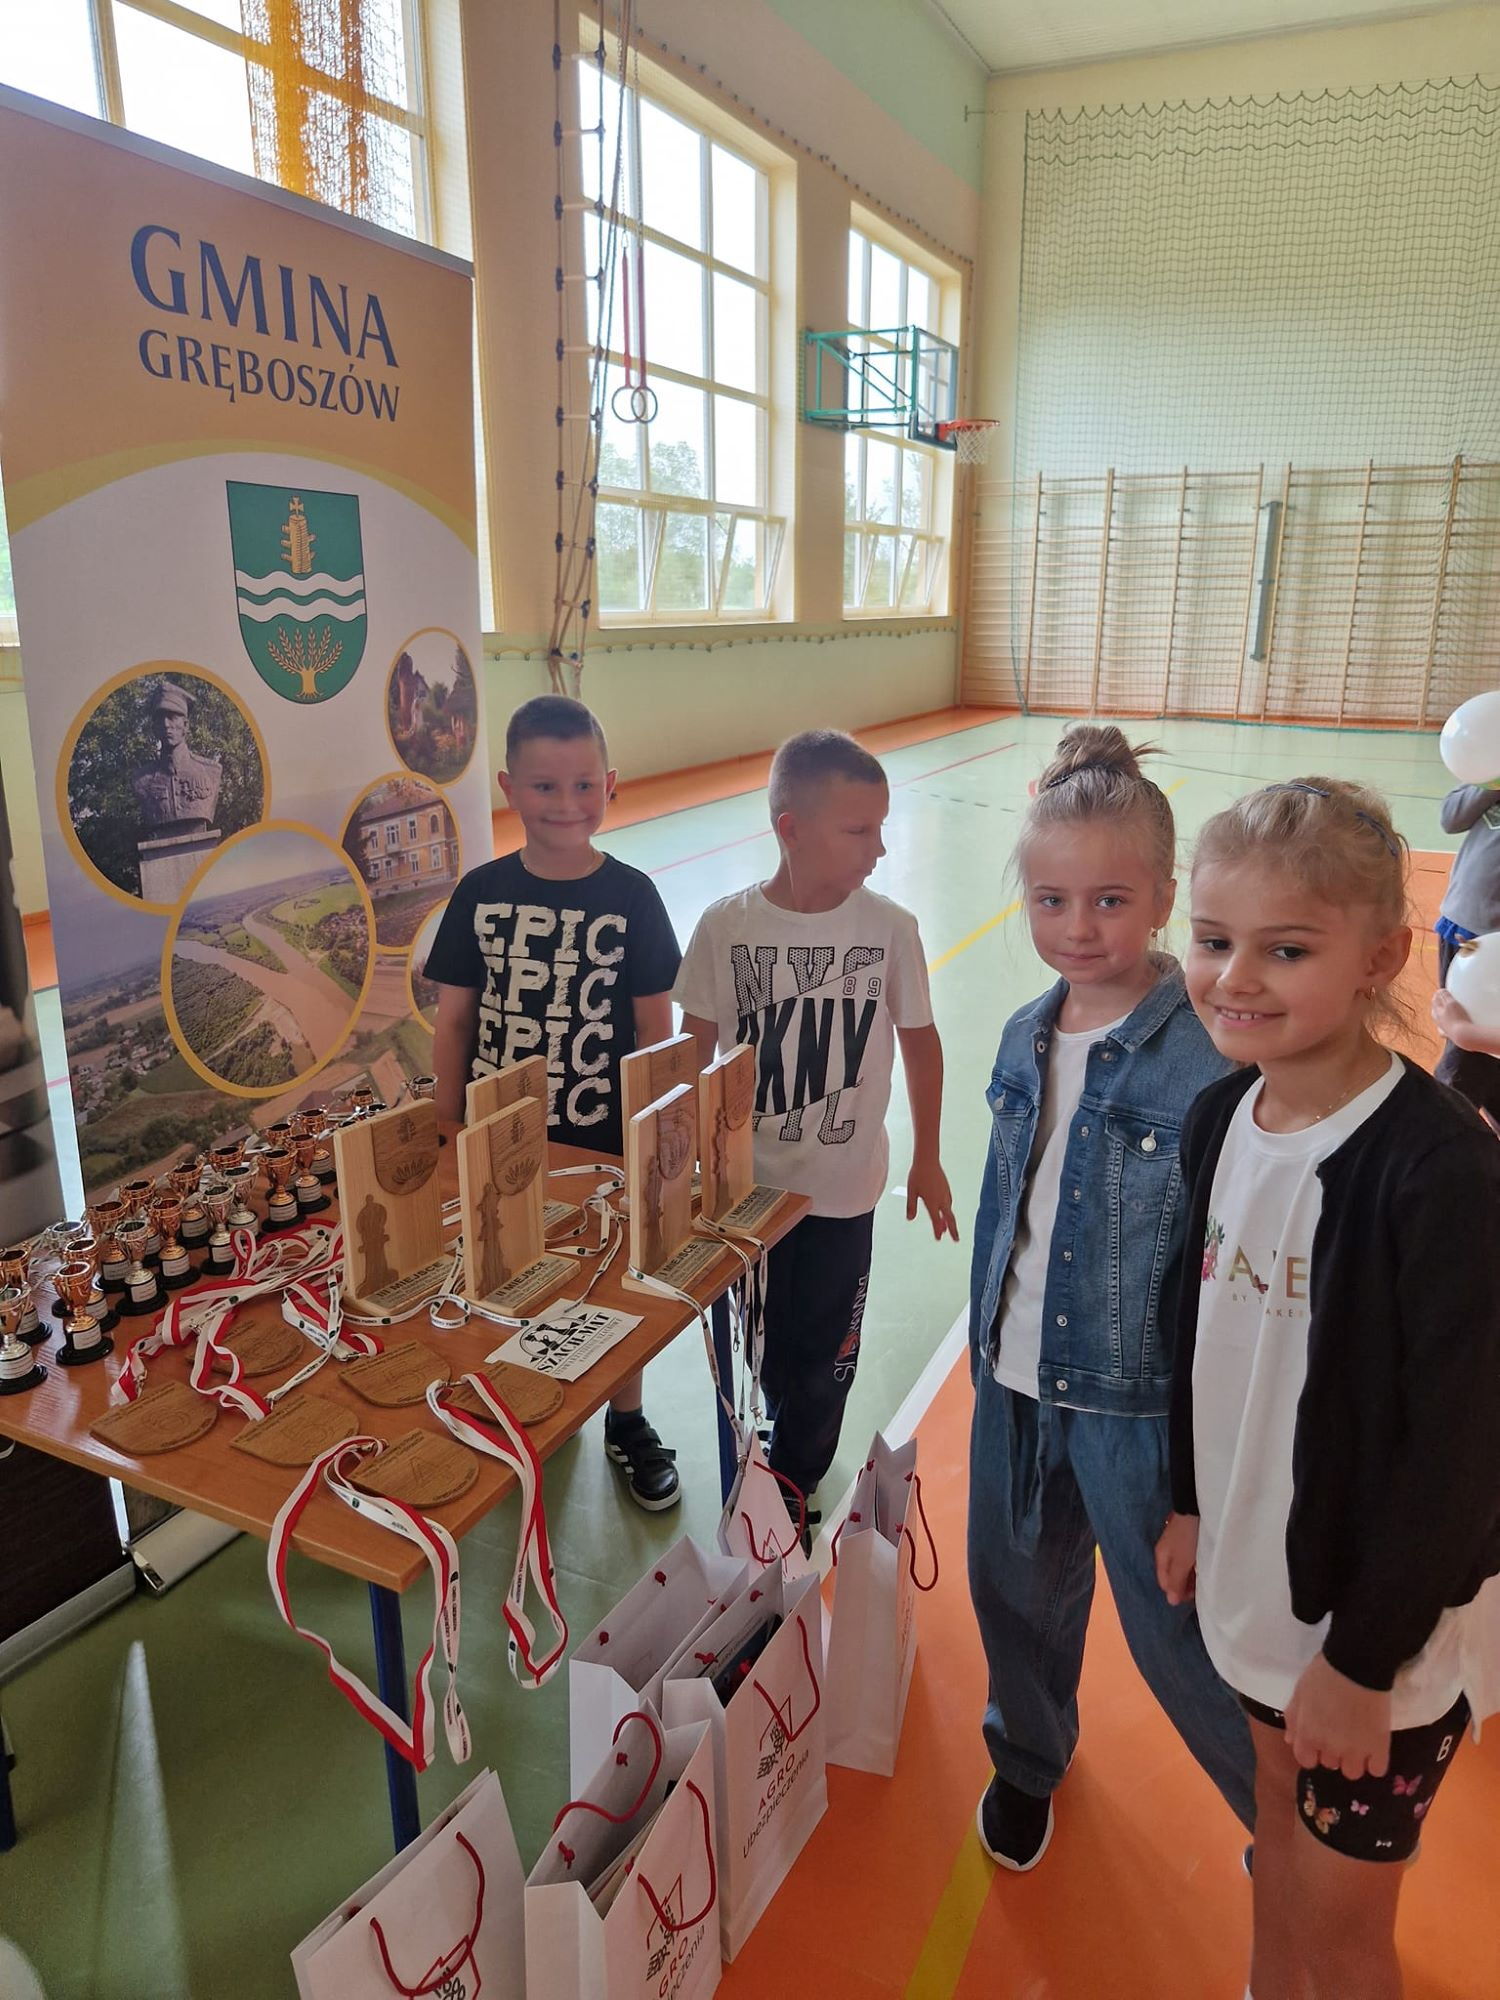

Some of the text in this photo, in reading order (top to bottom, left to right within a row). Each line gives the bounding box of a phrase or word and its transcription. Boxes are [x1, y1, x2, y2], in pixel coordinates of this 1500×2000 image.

[130, 225, 399, 369] GMINA
[138, 329, 400, 422] GRĘBOSZÓW
[474, 903, 627, 966] EPIC
[481, 954, 618, 1021] EPIC
[478, 1006, 613, 1077] EPIC
[504, 1261, 548, 1290] MIEJSCE
[537, 1311, 610, 1373] SZACH-MAT
[743, 1749, 810, 1859] Ubezpieczenia
[757, 1753, 795, 1816] AGRO
[659, 1936, 688, 2000] GRO
